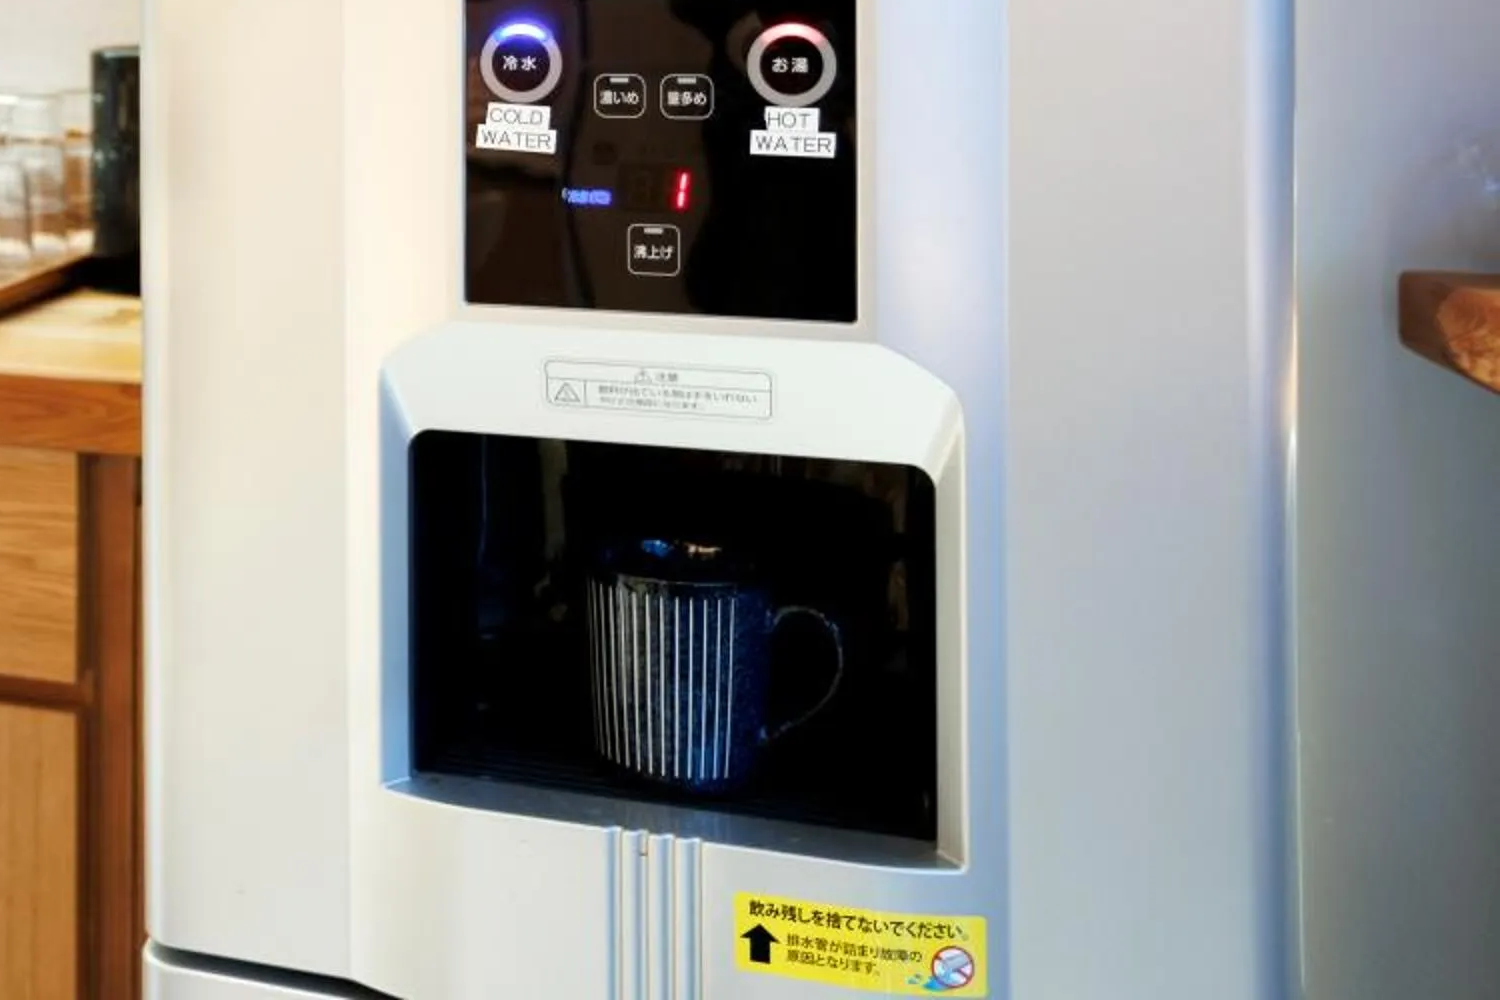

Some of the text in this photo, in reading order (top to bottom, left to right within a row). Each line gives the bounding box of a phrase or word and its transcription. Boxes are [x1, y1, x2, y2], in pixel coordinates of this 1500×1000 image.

[503, 55, 537, 71] 冷水
[771, 57, 809, 74] お湯
[489, 108, 543, 126] COLD
[767, 111, 809, 128] HOT
[481, 129, 551, 149] WATER
[755, 134, 832, 153] WATER
[677, 172, 689, 208] 1
[749, 900, 970, 942] 飲み残しを捨てないでください。
